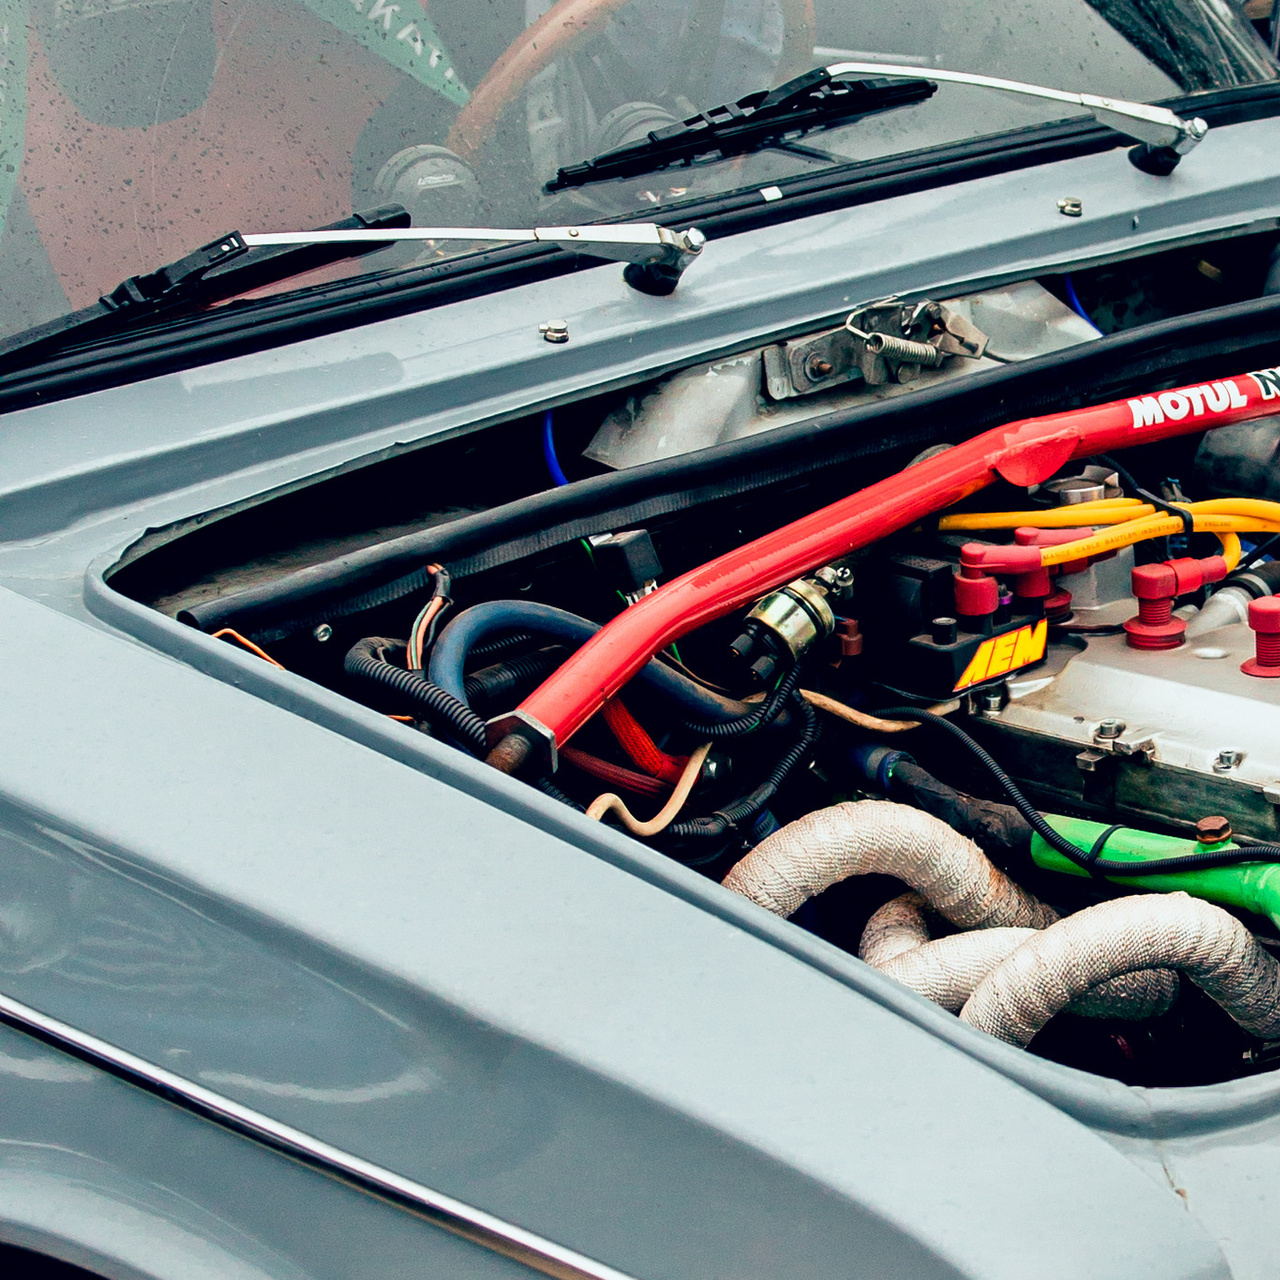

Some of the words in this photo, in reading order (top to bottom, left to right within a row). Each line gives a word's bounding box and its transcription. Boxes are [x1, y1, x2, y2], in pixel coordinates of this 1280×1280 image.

[1127, 380, 1248, 429] MOTUL
[1076, 541, 1100, 553] CABLE
[952, 617, 1048, 693] AEM
